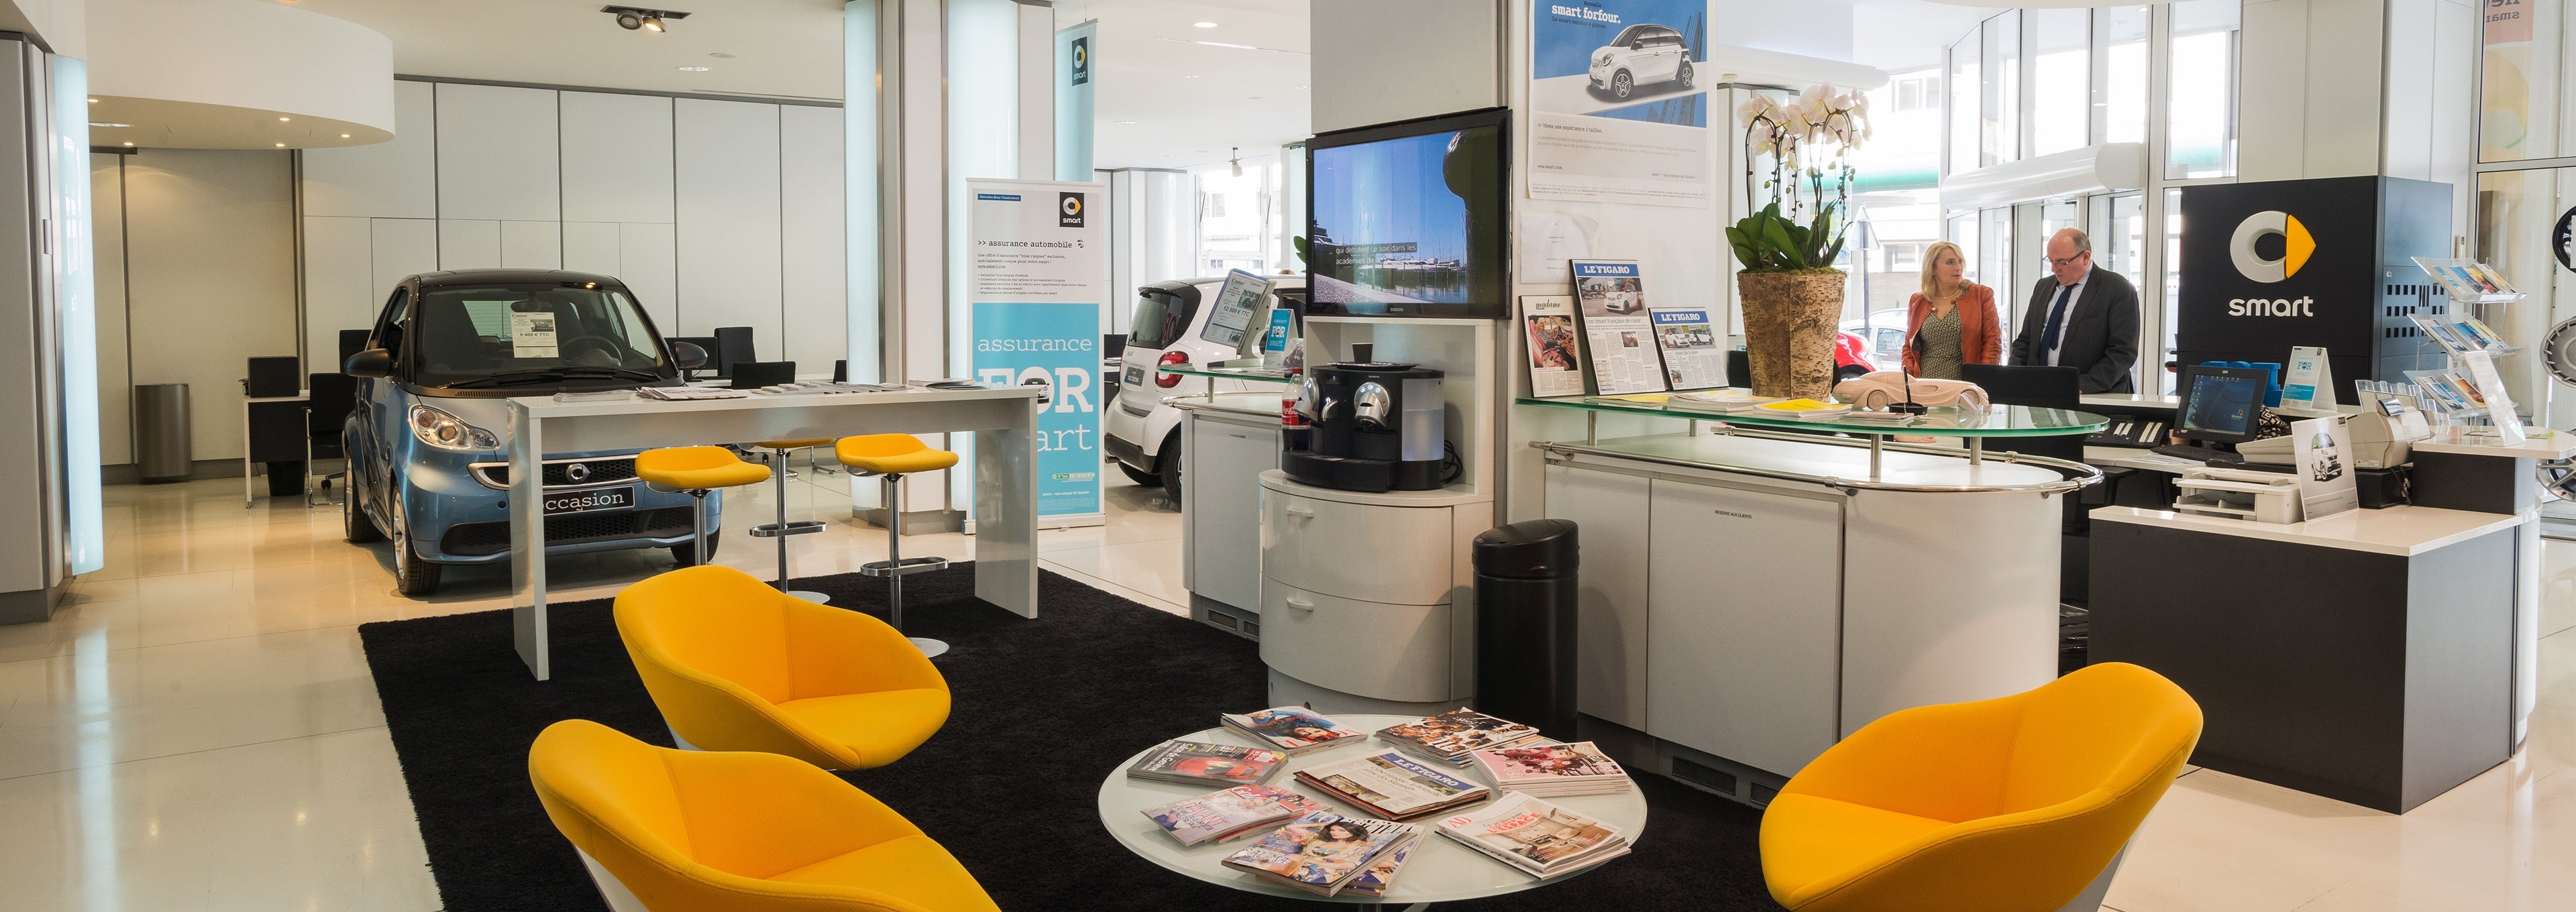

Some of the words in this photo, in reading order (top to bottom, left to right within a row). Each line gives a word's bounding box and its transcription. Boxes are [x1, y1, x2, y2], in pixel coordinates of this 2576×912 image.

[1552, 5, 1581, 17] smart
[1583, 7, 1621, 24] forfour.
[1073, 70, 1086, 80] smart
[1336, 247, 1344, 255] qui
[1584, 266, 1597, 274] LE
[1597, 266, 1630, 274] FIGARO
[2228, 296, 2314, 317] smart
[1672, 313, 1700, 321] FIGARO
[1271, 326, 1286, 338] FOR
[978, 338, 1092, 351] assurance
[2297, 361, 2312, 370] FOR
[1037, 424, 1092, 452] art
[543, 493, 625, 510] ccasion
[1173, 742, 1193, 752] Salon
[1148, 757, 1173, 771] Genève
[1393, 758, 1413, 771] LE
[1411, 765, 1460, 787] FIGARO
[1231, 786, 1261, 800] Gal
[1447, 815, 1472, 829] AD
[1487, 812, 1540, 834] L'ESPACE
